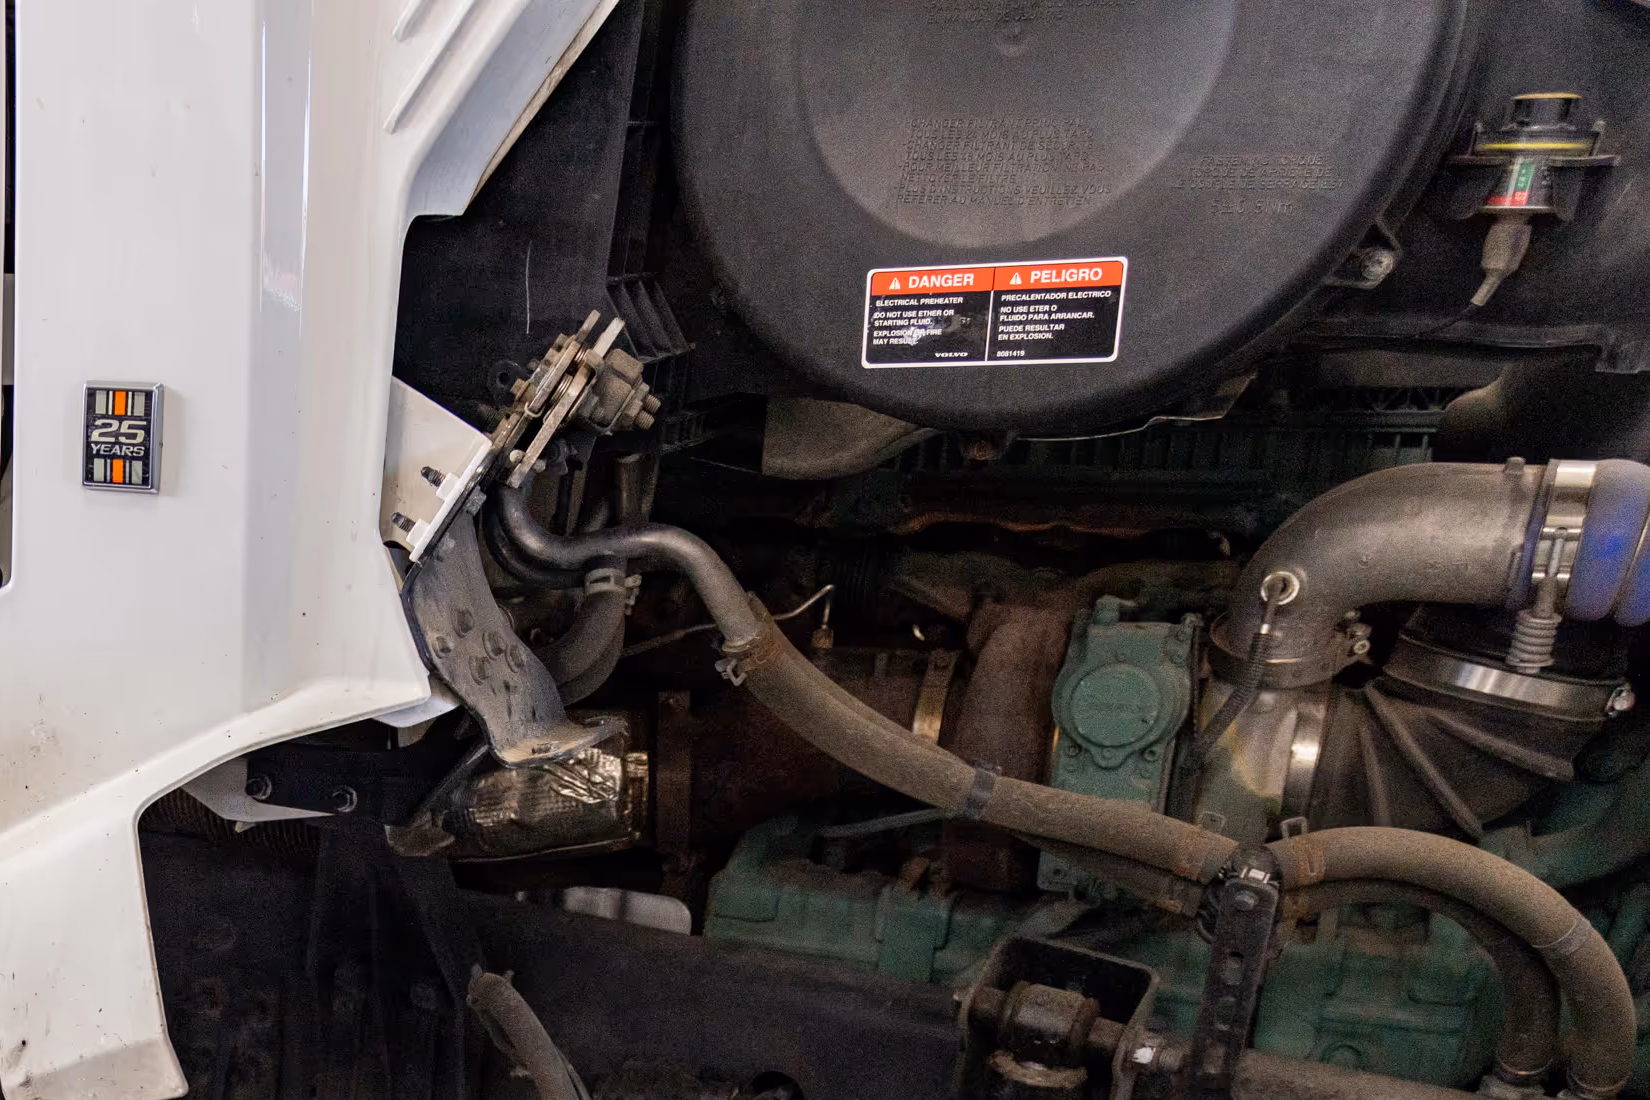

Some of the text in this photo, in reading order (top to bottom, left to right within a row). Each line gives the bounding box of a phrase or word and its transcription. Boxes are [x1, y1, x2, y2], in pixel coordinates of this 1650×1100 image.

[1030, 267, 1103, 284] PELIGRO
[908, 274, 975, 289] DANGER
[1001, 290, 1112, 302] PRECALENTADOR ELECTRICO
[876, 297, 964, 307] ELECTRICAL PREHEATER
[902, 310, 917, 318] USE
[918, 309, 943, 317] ETHER
[1013, 305, 1028, 313] USE
[999, 314, 1027, 322] FLUIDO
[1050, 312, 1095, 320] ARRANCAR.
[874, 318, 933, 327] STARTING FLUID.
[998, 323, 1065, 332] PUEDE RESULTAR
[873, 329, 913, 337] EXPLOSION
[926, 328, 943, 336] FIRE
[998, 332, 1054, 341] EN EXPLOSION.
[90, 419, 147, 444] 25
[90, 443, 145, 457] YEARS
